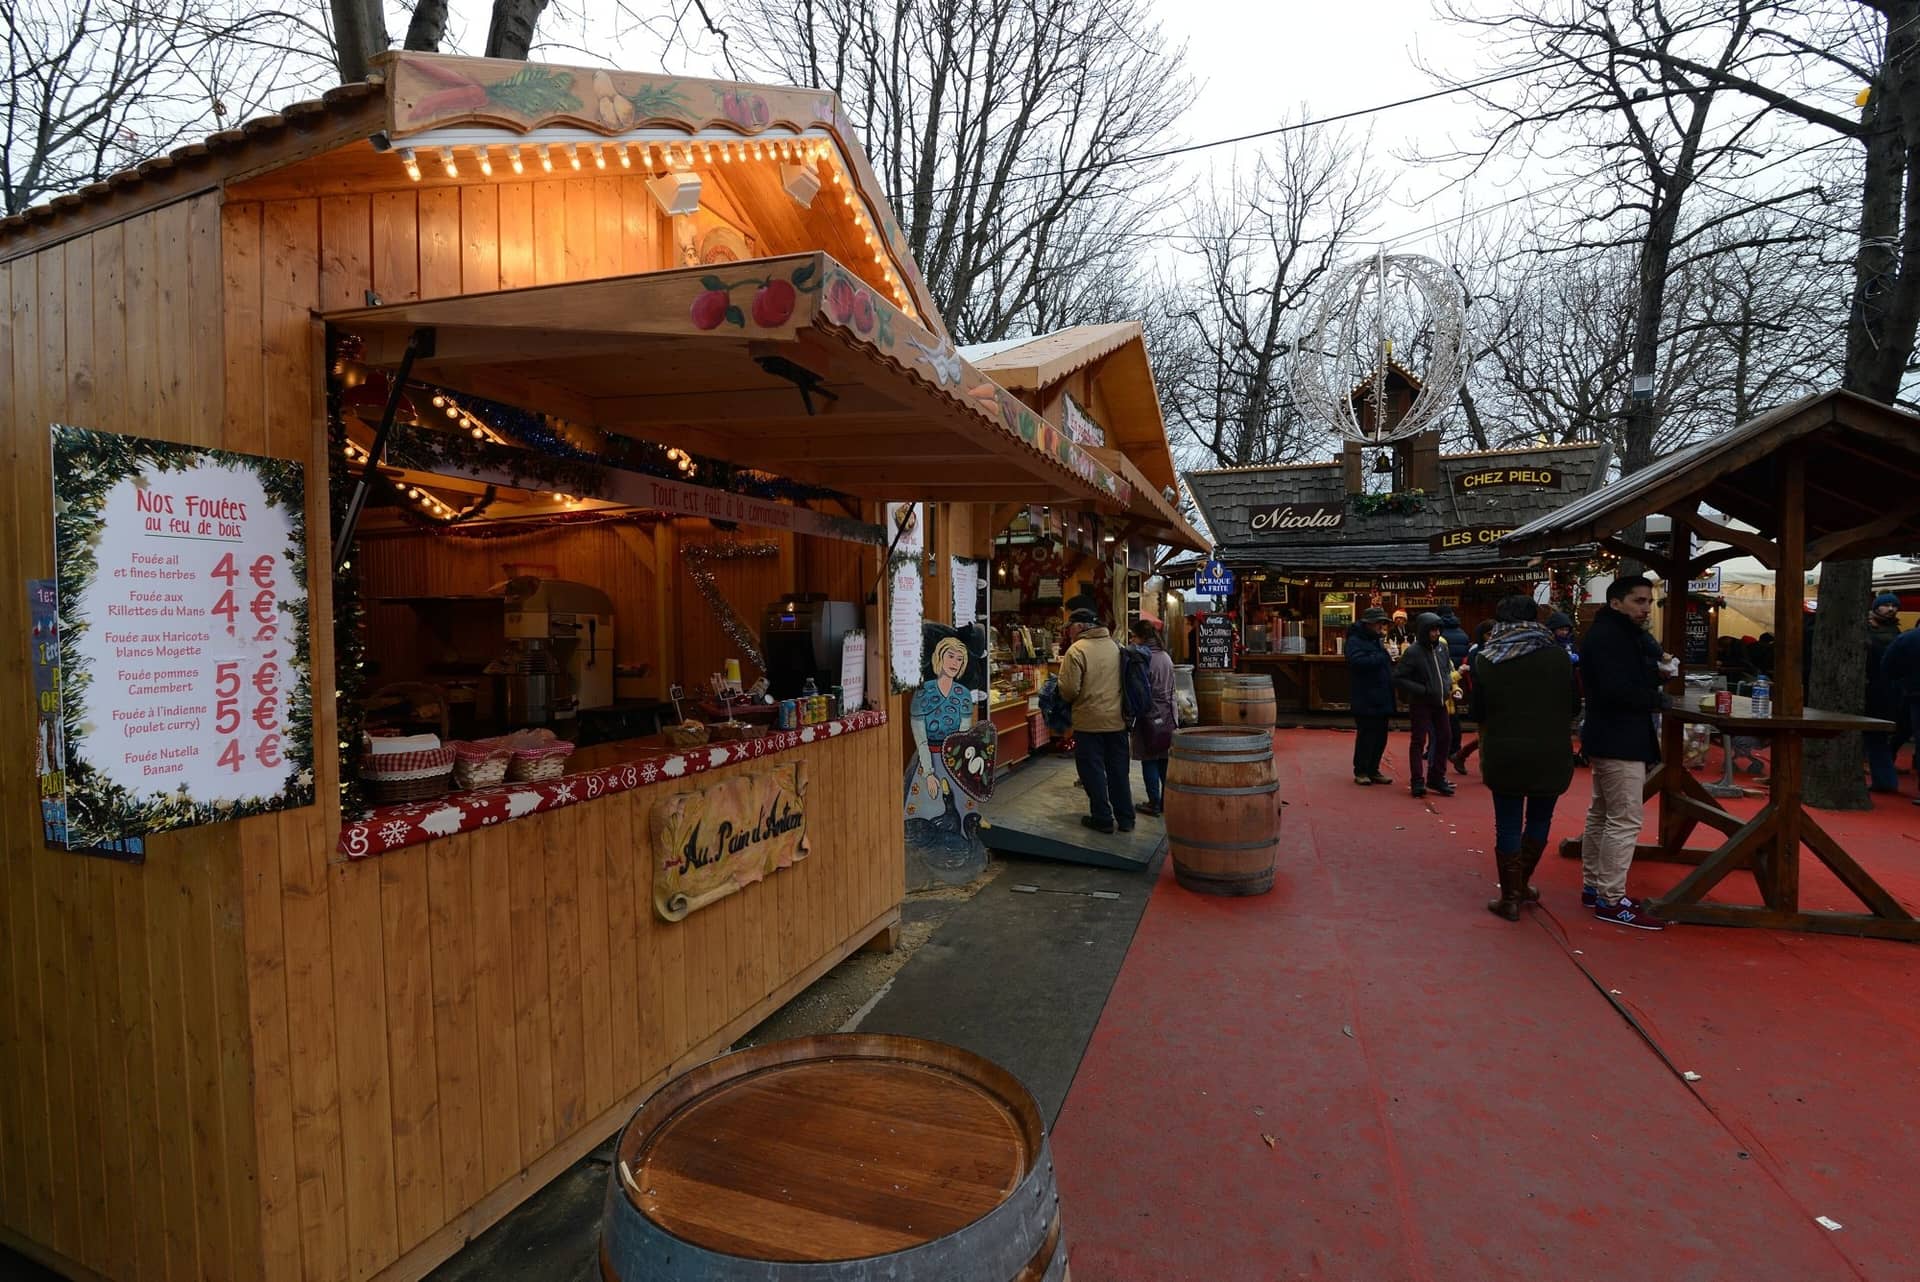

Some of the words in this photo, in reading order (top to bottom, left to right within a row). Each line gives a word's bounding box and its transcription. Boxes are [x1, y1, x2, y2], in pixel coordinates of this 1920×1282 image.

[1463, 471, 1504, 488] CHEZ
[1509, 470, 1552, 484] PIELO
[137, 489, 174, 514] Nos
[185, 495, 247, 521] Fouées
[650, 482, 677, 508] Tout
[683, 492, 698, 512] est
[704, 493, 721, 516] fait
[736, 497, 744, 520] la
[749, 504, 790, 525] commande
[1251, 506, 1342, 529] Nicolas
[145, 517, 161, 531] au
[169, 518, 190, 534] feu
[197, 520, 212, 535] de
[218, 522, 241, 537] bois
[1442, 531, 1473, 547] LES
[131, 553, 164, 565] Fouée
[166, 554, 179, 565] ail
[113, 567, 127, 577] et
[130, 567, 157, 578] fines
[159, 568, 196, 580] herbes
[210, 552, 239, 586] 4
[249, 555, 276, 589] €
[1380, 580, 1426, 590] AMERICAIN
[130, 591, 162, 602] Fouée
[164, 593, 183, 602] aux
[108, 605, 159, 616] Rillettes
[160, 605, 175, 616] du
[176, 606, 206, 616] Mans
[210, 589, 240, 623] 4
[250, 590, 276, 624] €
[105, 632, 139, 643] Fouée
[141, 634, 161, 643] aux
[163, 631, 210, 642] Haricots
[116, 646, 154, 657] blancs
[156, 646, 201, 658] Mogette
[118, 670, 151, 681] Fouée
[154, 670, 199, 683] pommes
[215, 662, 241, 698] 5
[252, 662, 278, 696] €
[128, 683, 194, 695] Camembert
[112, 709, 146, 720] Fouée
[148, 707, 155, 717] à
[157, 706, 207, 717] l'indienne
[215, 698, 241, 734] 5
[252, 696, 278, 730] €
[124, 719, 165, 738] (poulet
[167, 717, 200, 732] curry)
[125, 752, 157, 763] Fouée
[160, 746, 199, 758] Nutella
[216, 738, 245, 773] 4
[255, 733, 282, 768] €
[143, 762, 184, 776] Banane
[714, 820, 750, 862] Pain
